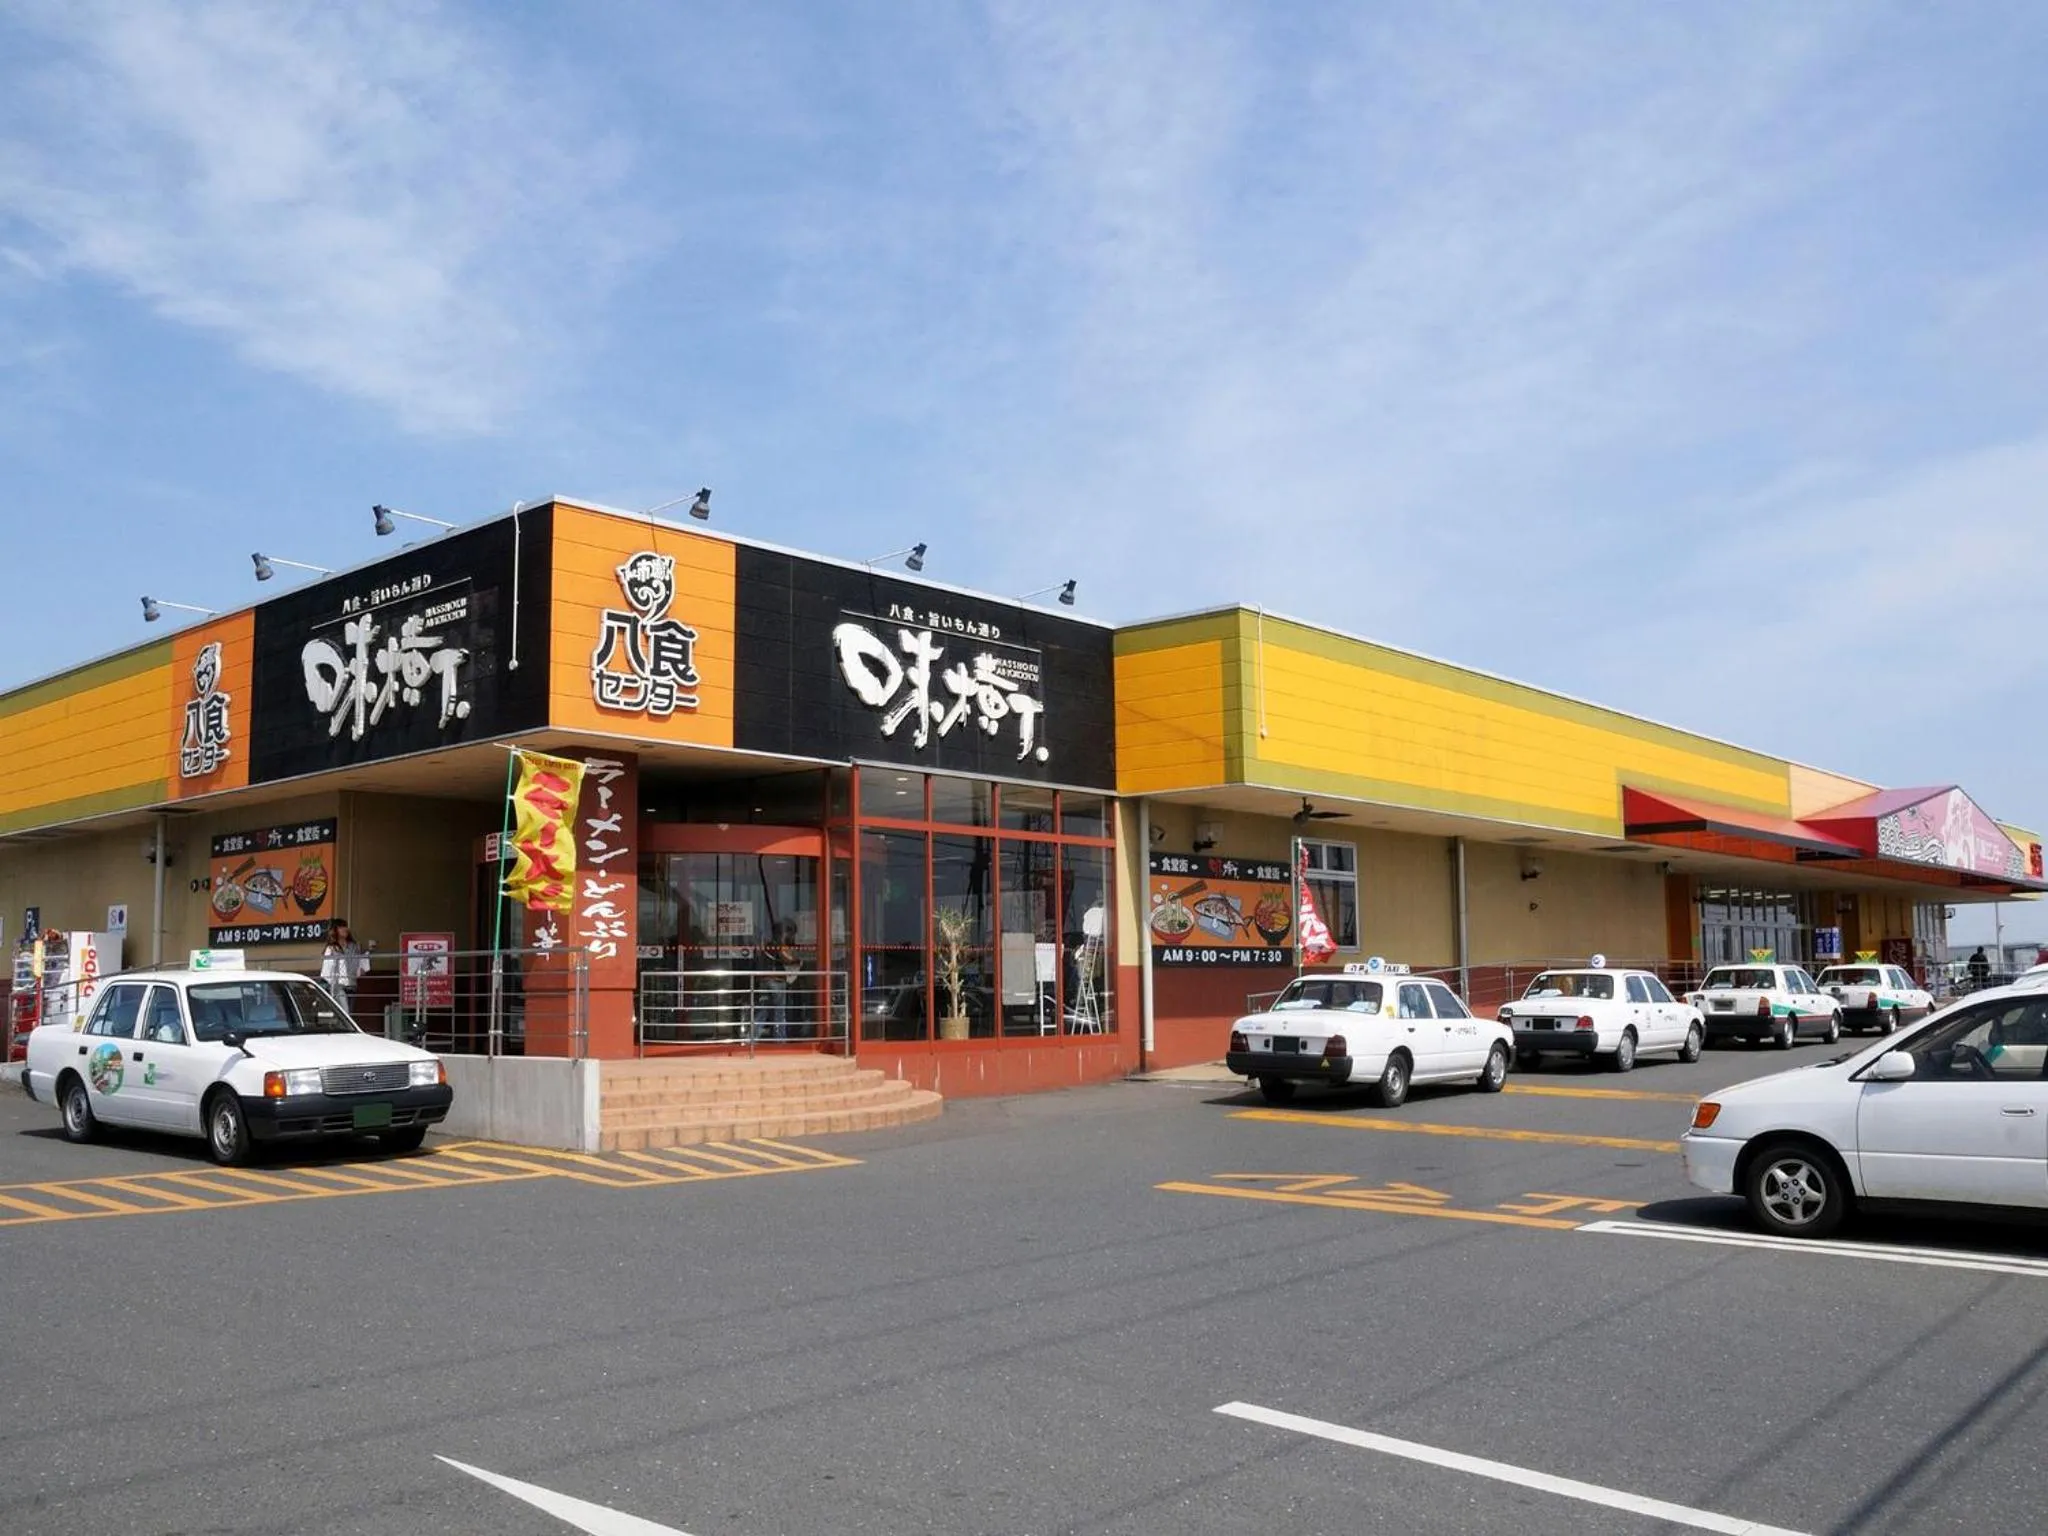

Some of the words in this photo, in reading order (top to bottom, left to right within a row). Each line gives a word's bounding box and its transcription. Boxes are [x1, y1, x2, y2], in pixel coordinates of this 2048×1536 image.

[593, 609, 700, 686] 八食
[593, 669, 699, 715] センター
[183, 694, 228, 744] 八食
[182, 744, 229, 776] センター
